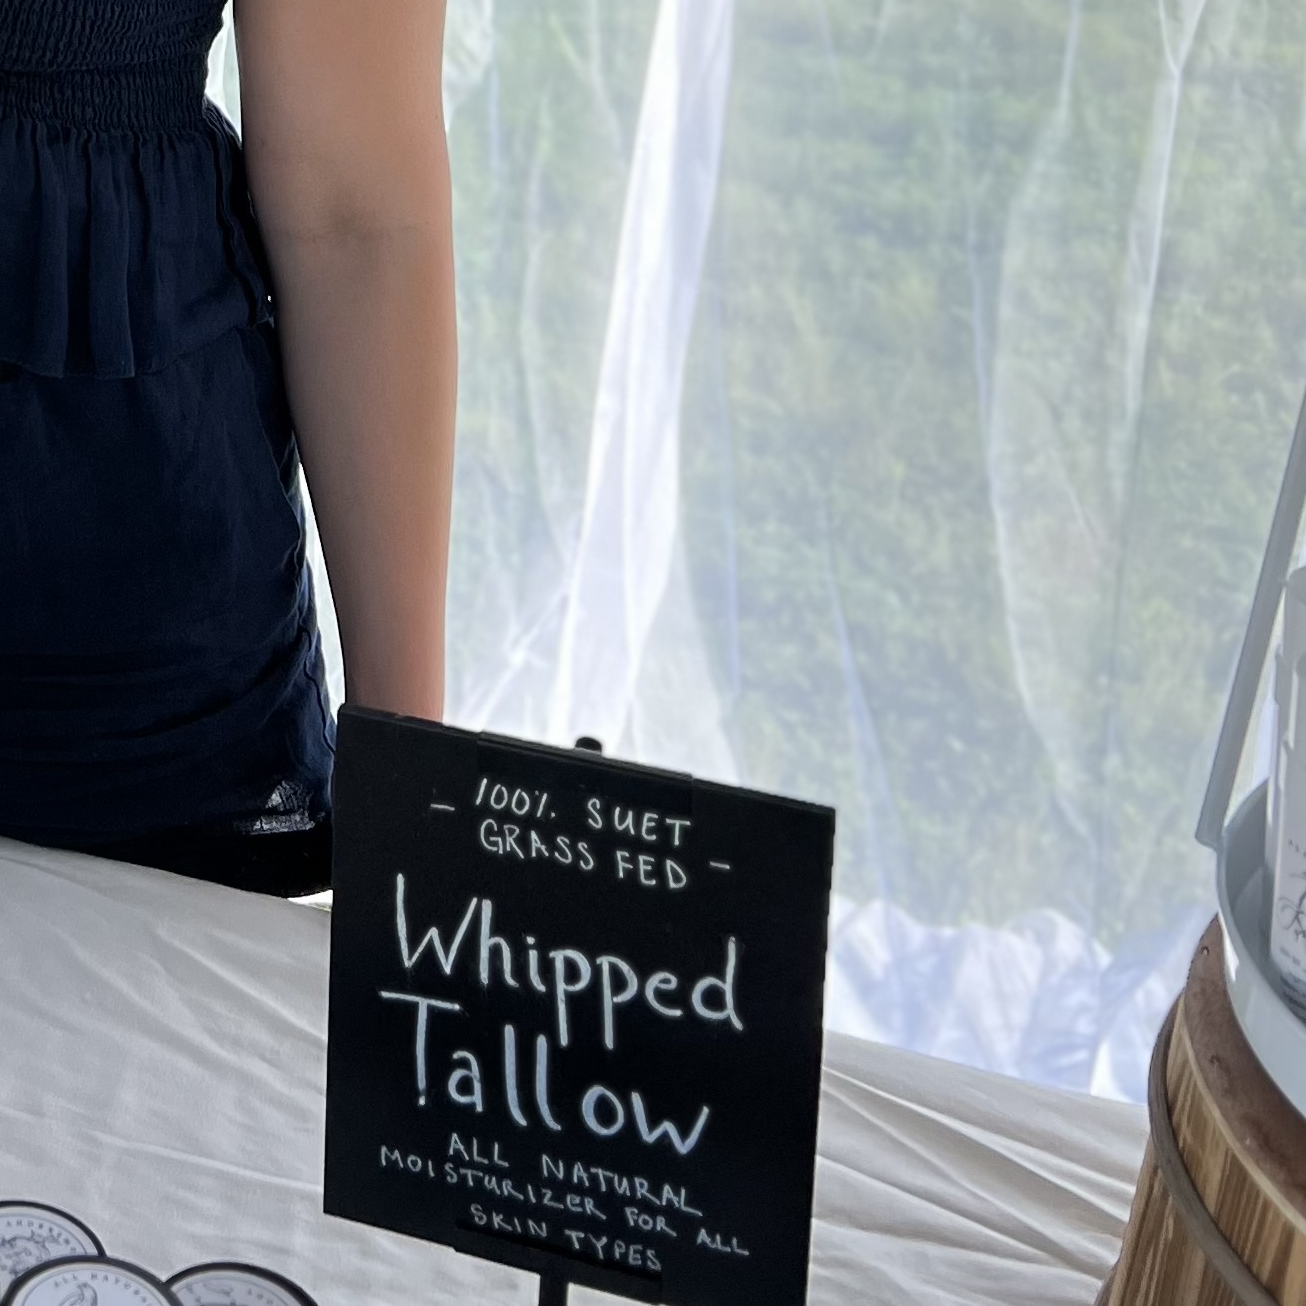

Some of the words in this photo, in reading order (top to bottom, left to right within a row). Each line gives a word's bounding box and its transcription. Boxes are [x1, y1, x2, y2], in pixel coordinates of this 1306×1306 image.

[480, 819, 594, 870] GRASS
[616, 850, 687, 889] FED
[587, 798, 691, 846] SUET
[397, 873, 744, 1050] Whipped
[379, 990, 710, 1155] Tallow
[380, 1145, 607, 1220] MOISTURIZER
[624, 1207, 677, 1237] FOR
[696, 1228, 749, 1255] ALL
[448, 1133, 510, 1168] ALL
[542, 1154, 703, 1216] NATURAL
[470, 1203, 547, 1237] SKIN
[564, 1229, 662, 1271] TYPES
